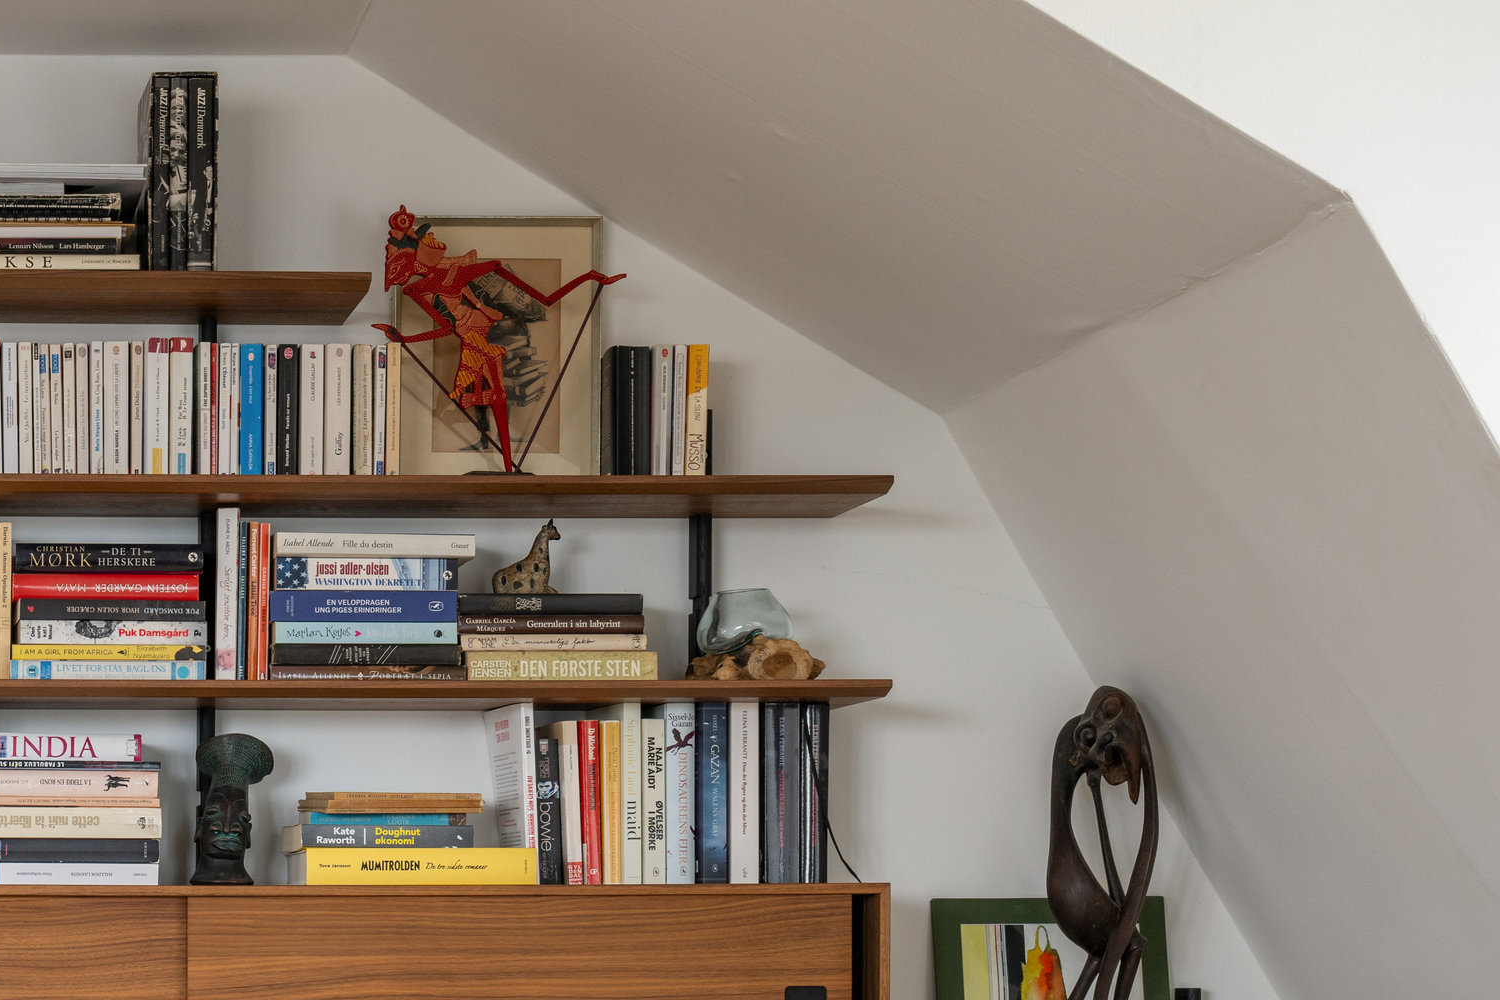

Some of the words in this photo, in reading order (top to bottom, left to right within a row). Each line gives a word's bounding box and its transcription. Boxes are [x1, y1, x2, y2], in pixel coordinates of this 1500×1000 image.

[197, 88, 206, 105] JAZZ
[196, 109, 206, 149] Danmark
[73, 243, 105, 252] Hamberger
[283, 538, 306, 548] Isabel
[307, 538, 334, 548] Allende
[342, 539, 359, 548] Fille
[360, 539, 370, 548] du
[372, 539, 393, 548] destin
[111, 547, 127, 555] DE
[131, 547, 141, 555] TI
[29, 552, 92, 567] MØRK
[97, 557, 156, 567] HERSKERE
[315, 561, 338, 577] jussi
[340, 561, 389, 575] adler-olsen
[56, 583, 86, 592] MAYA
[315, 577, 377, 586] WASHINGTON
[379, 578, 422, 587] DEKRETET
[94, 583, 143, 593] GAARDER
[147, 583, 188, 593] JOSTEIN
[526, 619, 568, 628] Generalen
[575, 619, 587, 628] sin
[589, 619, 621, 631] labyrint
[118, 628, 137, 637] Puk
[138, 627, 189, 639] Damsgård
[133, 652, 170, 660] Nyamayaro
[57, 664, 82, 673] LIVET
[85, 662, 123, 672] FORSTÅS
[127, 664, 167, 672] BAGLÆNS
[470, 660, 512, 669] CARSTEN
[520, 661, 547, 677] DEN
[551, 660, 602, 677] FØRSTE
[606, 661, 641, 677] STEN
[470, 669, 512, 678] JENSEN
[11, 736, 99, 758] INDIA
[647, 737, 655, 767] MARIE
[655, 748, 663, 773] NAJA
[710, 744, 720, 784] GAZAN
[647, 768, 655, 790] AIDT
[678, 752, 688, 835] DINOSAURENS
[627, 801, 640, 841] maid
[655, 801, 663, 840] ØVELSER
[333, 827, 355, 836] Kate
[539, 802, 554, 851] bowie
[375, 828, 420, 838] Doughnut
[316, 836, 355, 844] Raworth
[375, 837, 415, 845] økonomi
[678, 839, 688, 864] FJER
[360, 860, 420, 871] MUMITROLDEN
